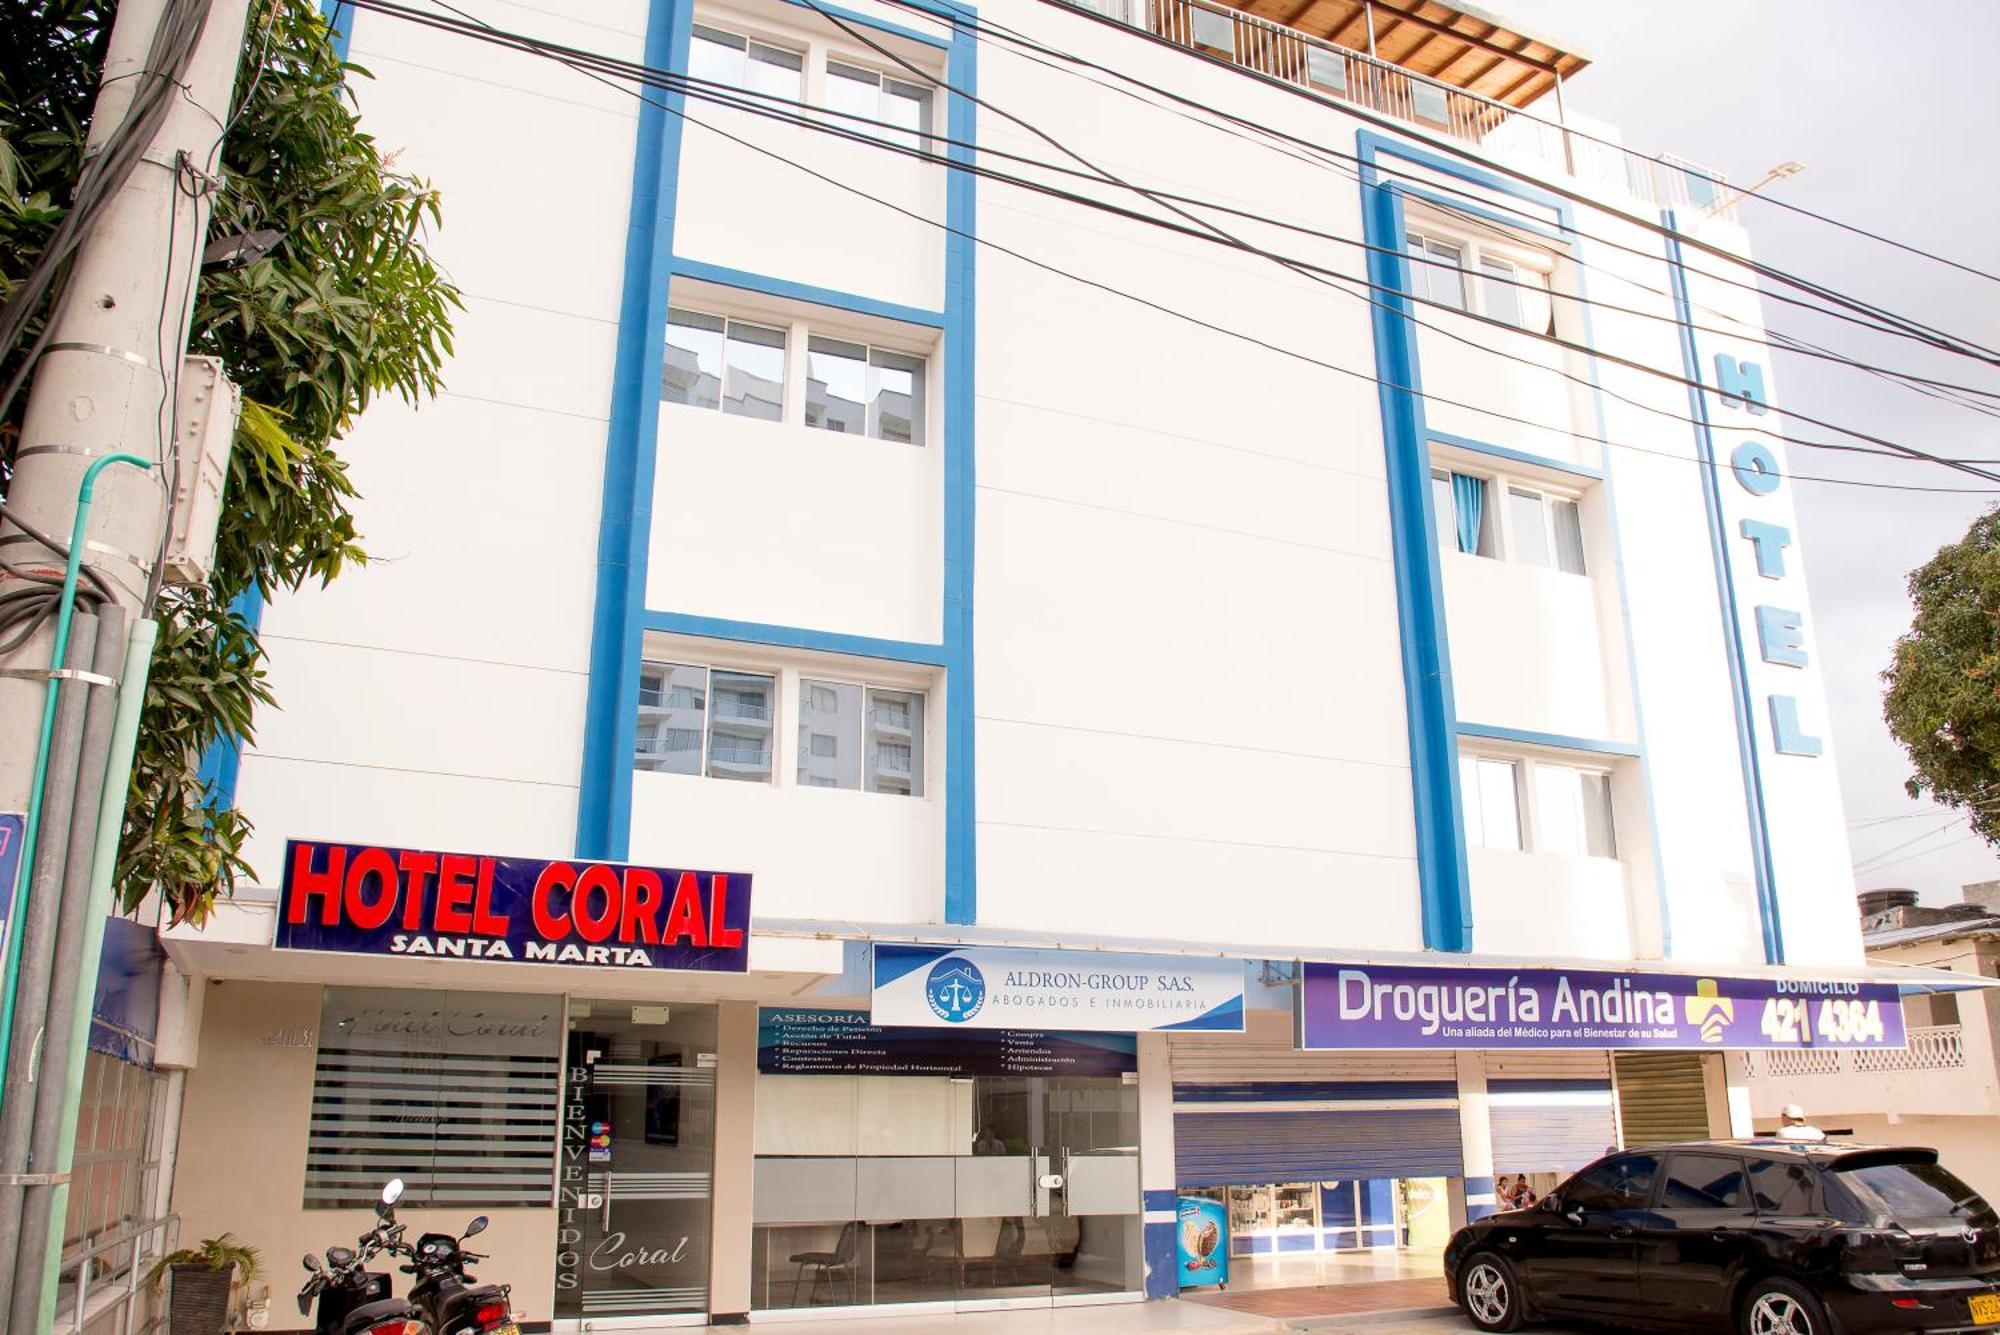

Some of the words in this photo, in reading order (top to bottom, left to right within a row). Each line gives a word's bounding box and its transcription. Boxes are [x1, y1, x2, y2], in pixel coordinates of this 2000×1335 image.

[1714, 353, 1823, 758] HOTEL
[287, 842, 510, 937] HOTEL
[531, 861, 743, 949] CORAL
[390, 933, 513, 959] SANTA
[525, 940, 653, 967] MARTA
[1004, 971, 1149, 991] ALDRON-GROUP
[1157, 975, 1195, 992] S.A.S.
[1775, 980, 1860, 995] DOMICILIO
[991, 994, 1078, 1008] ABOGADOS
[1090, 997, 1097, 1008] E
[1105, 997, 1207, 1009] INMOBILIARIA
[1338, 969, 1540, 1036] Droguería
[1551, 975, 1676, 1025] Andina
[770, 1014, 867, 1024] ASESORÍA
[783, 1024, 825, 1032] Derecho
[1760, 997, 1812, 1043] 421
[1007, 1030, 1045, 1038] Compra
[1442, 1026, 1464, 1037] Una
[1465, 1026, 1496, 1037] aliada
[1497, 1026, 1513, 1037] del
[1550, 1029, 1573, 1039] para
[1573, 1028, 1582, 1037] el
[1583, 1028, 1627, 1038] Bienestar
[1628, 1028, 1639, 1038] de
[1640, 1030, 1652, 1038] su
[1653, 1028, 1678, 1038] Salud
[1007, 1047, 1052, 1055] Arriendos
[557, 1067, 589, 1289] BIENVENIDOS
[589, 1231, 689, 1271] Coral
